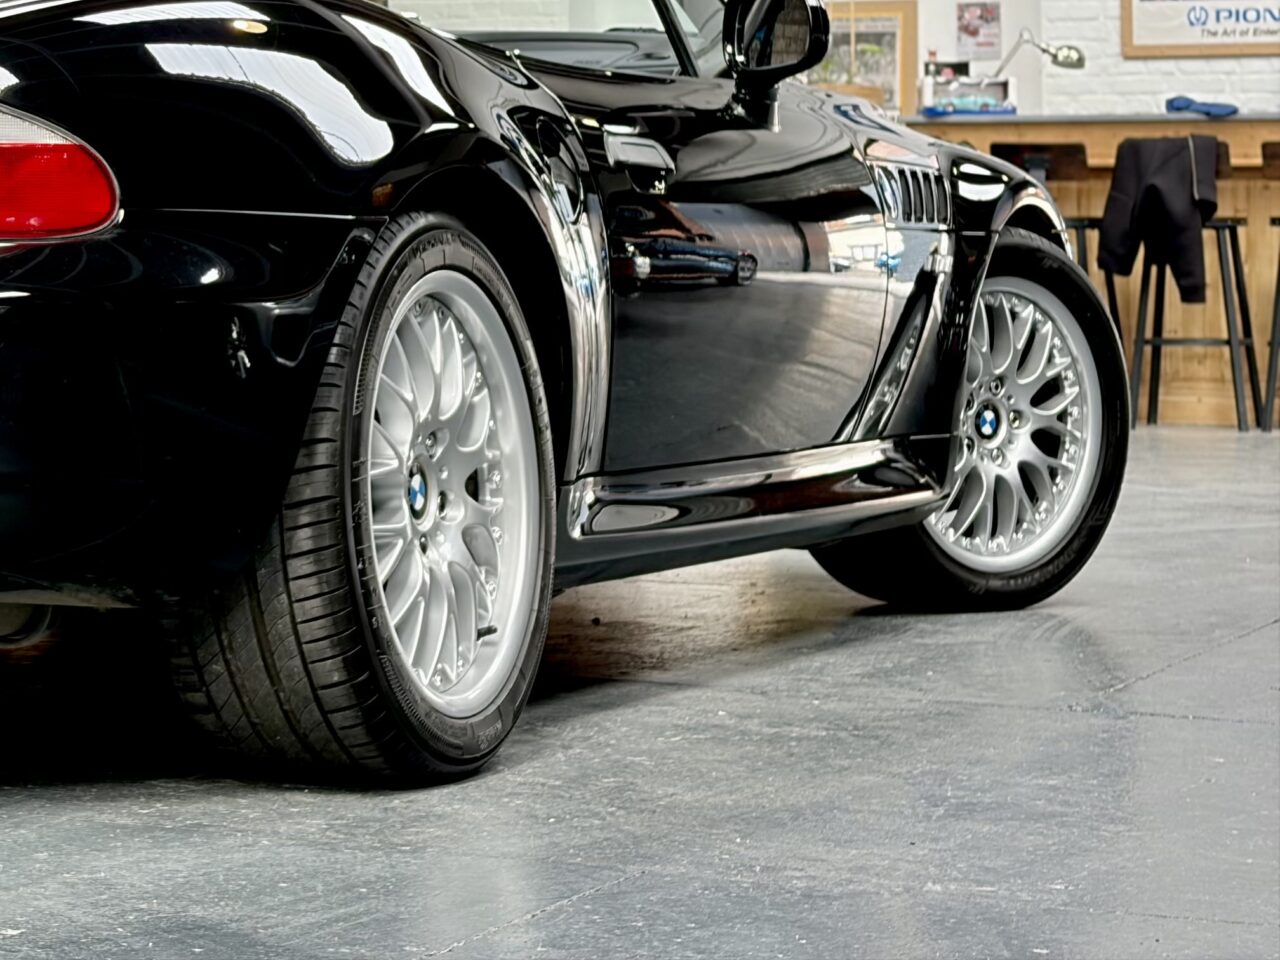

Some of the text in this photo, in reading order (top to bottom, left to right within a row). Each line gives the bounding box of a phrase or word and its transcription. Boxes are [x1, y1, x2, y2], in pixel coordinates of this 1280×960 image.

[1215, 7, 1280, 24] PION
[1201, 28, 1218, 38] The
[1221, 27, 1236, 38] Art
